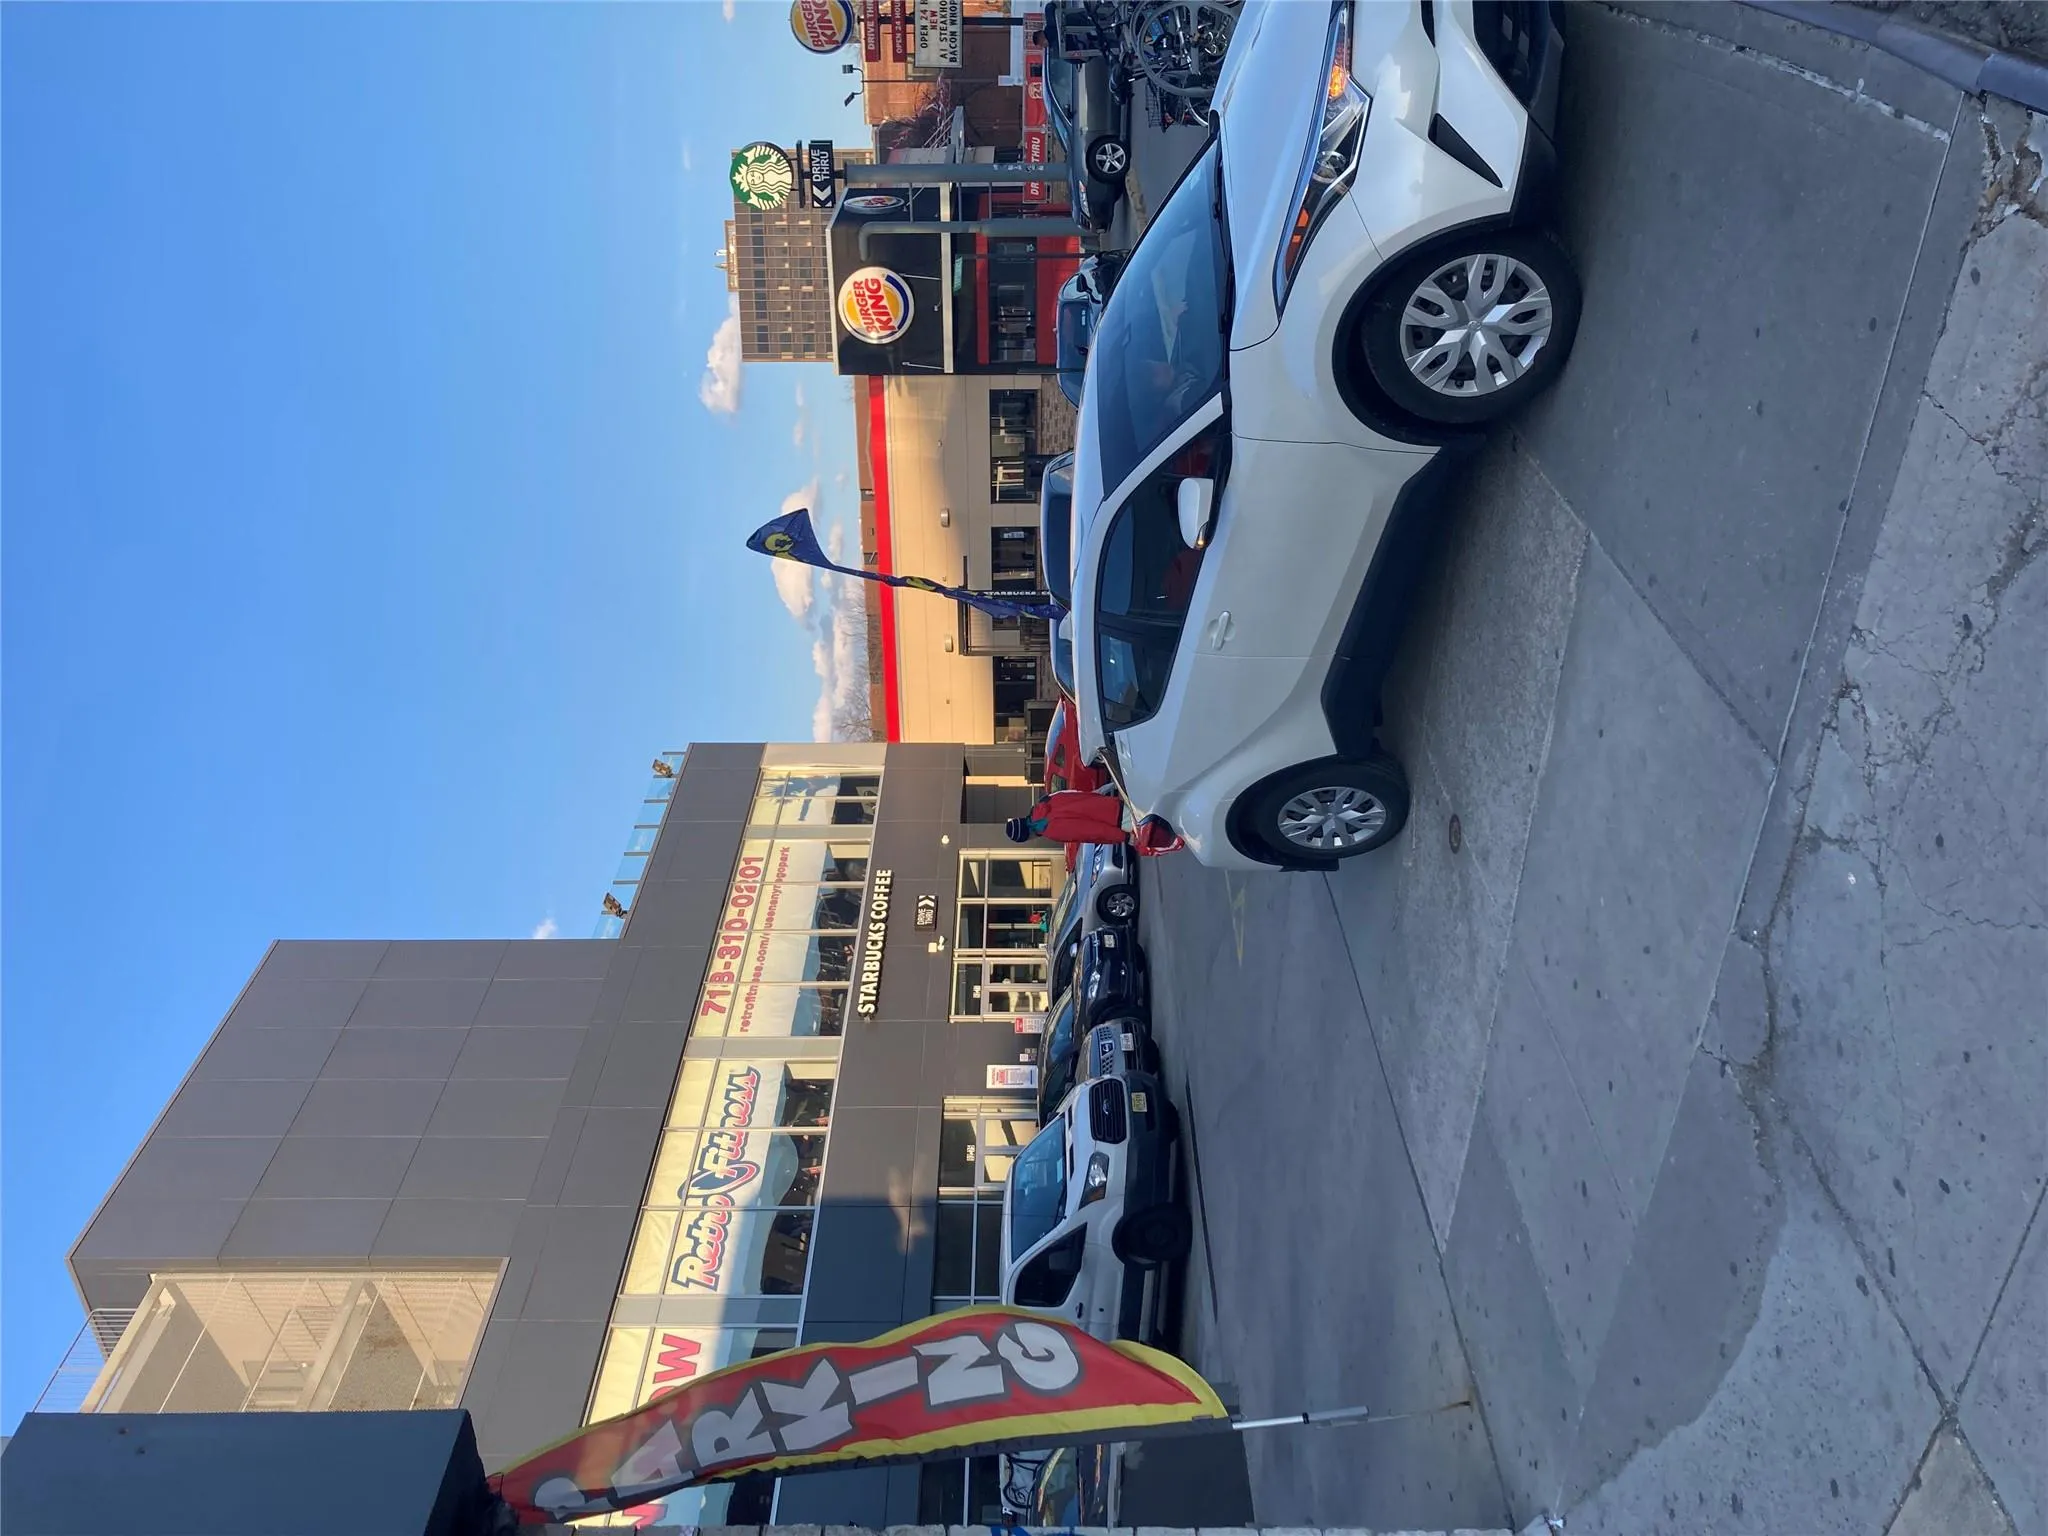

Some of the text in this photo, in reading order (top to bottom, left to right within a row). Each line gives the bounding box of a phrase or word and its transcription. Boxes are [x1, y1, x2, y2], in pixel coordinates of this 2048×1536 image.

[895, 21, 902, 31] 24
[920, 9, 928, 21] 24
[867, 21, 875, 50] DRIVE
[920, 25, 928, 48] OPEN
[949, 31, 957, 63] BACON
[811, 149, 821, 182] DRIVE
[1031, 137, 1041, 163] THRU
[820, 151, 830, 181] THRU
[853, 280, 880, 333] BURGER
[864, 278, 896, 331] KING
[916, 908, 926, 925] DRIVE
[925, 909, 934, 925] THRU
[701, 857, 763, 1016] 718-310-0201
[857, 869, 892, 1014] STARBUCKS COFFEE
[671, 1066, 761, 1291] Retro Fitness
[534, 1323, 1079, 1519] PARKING
